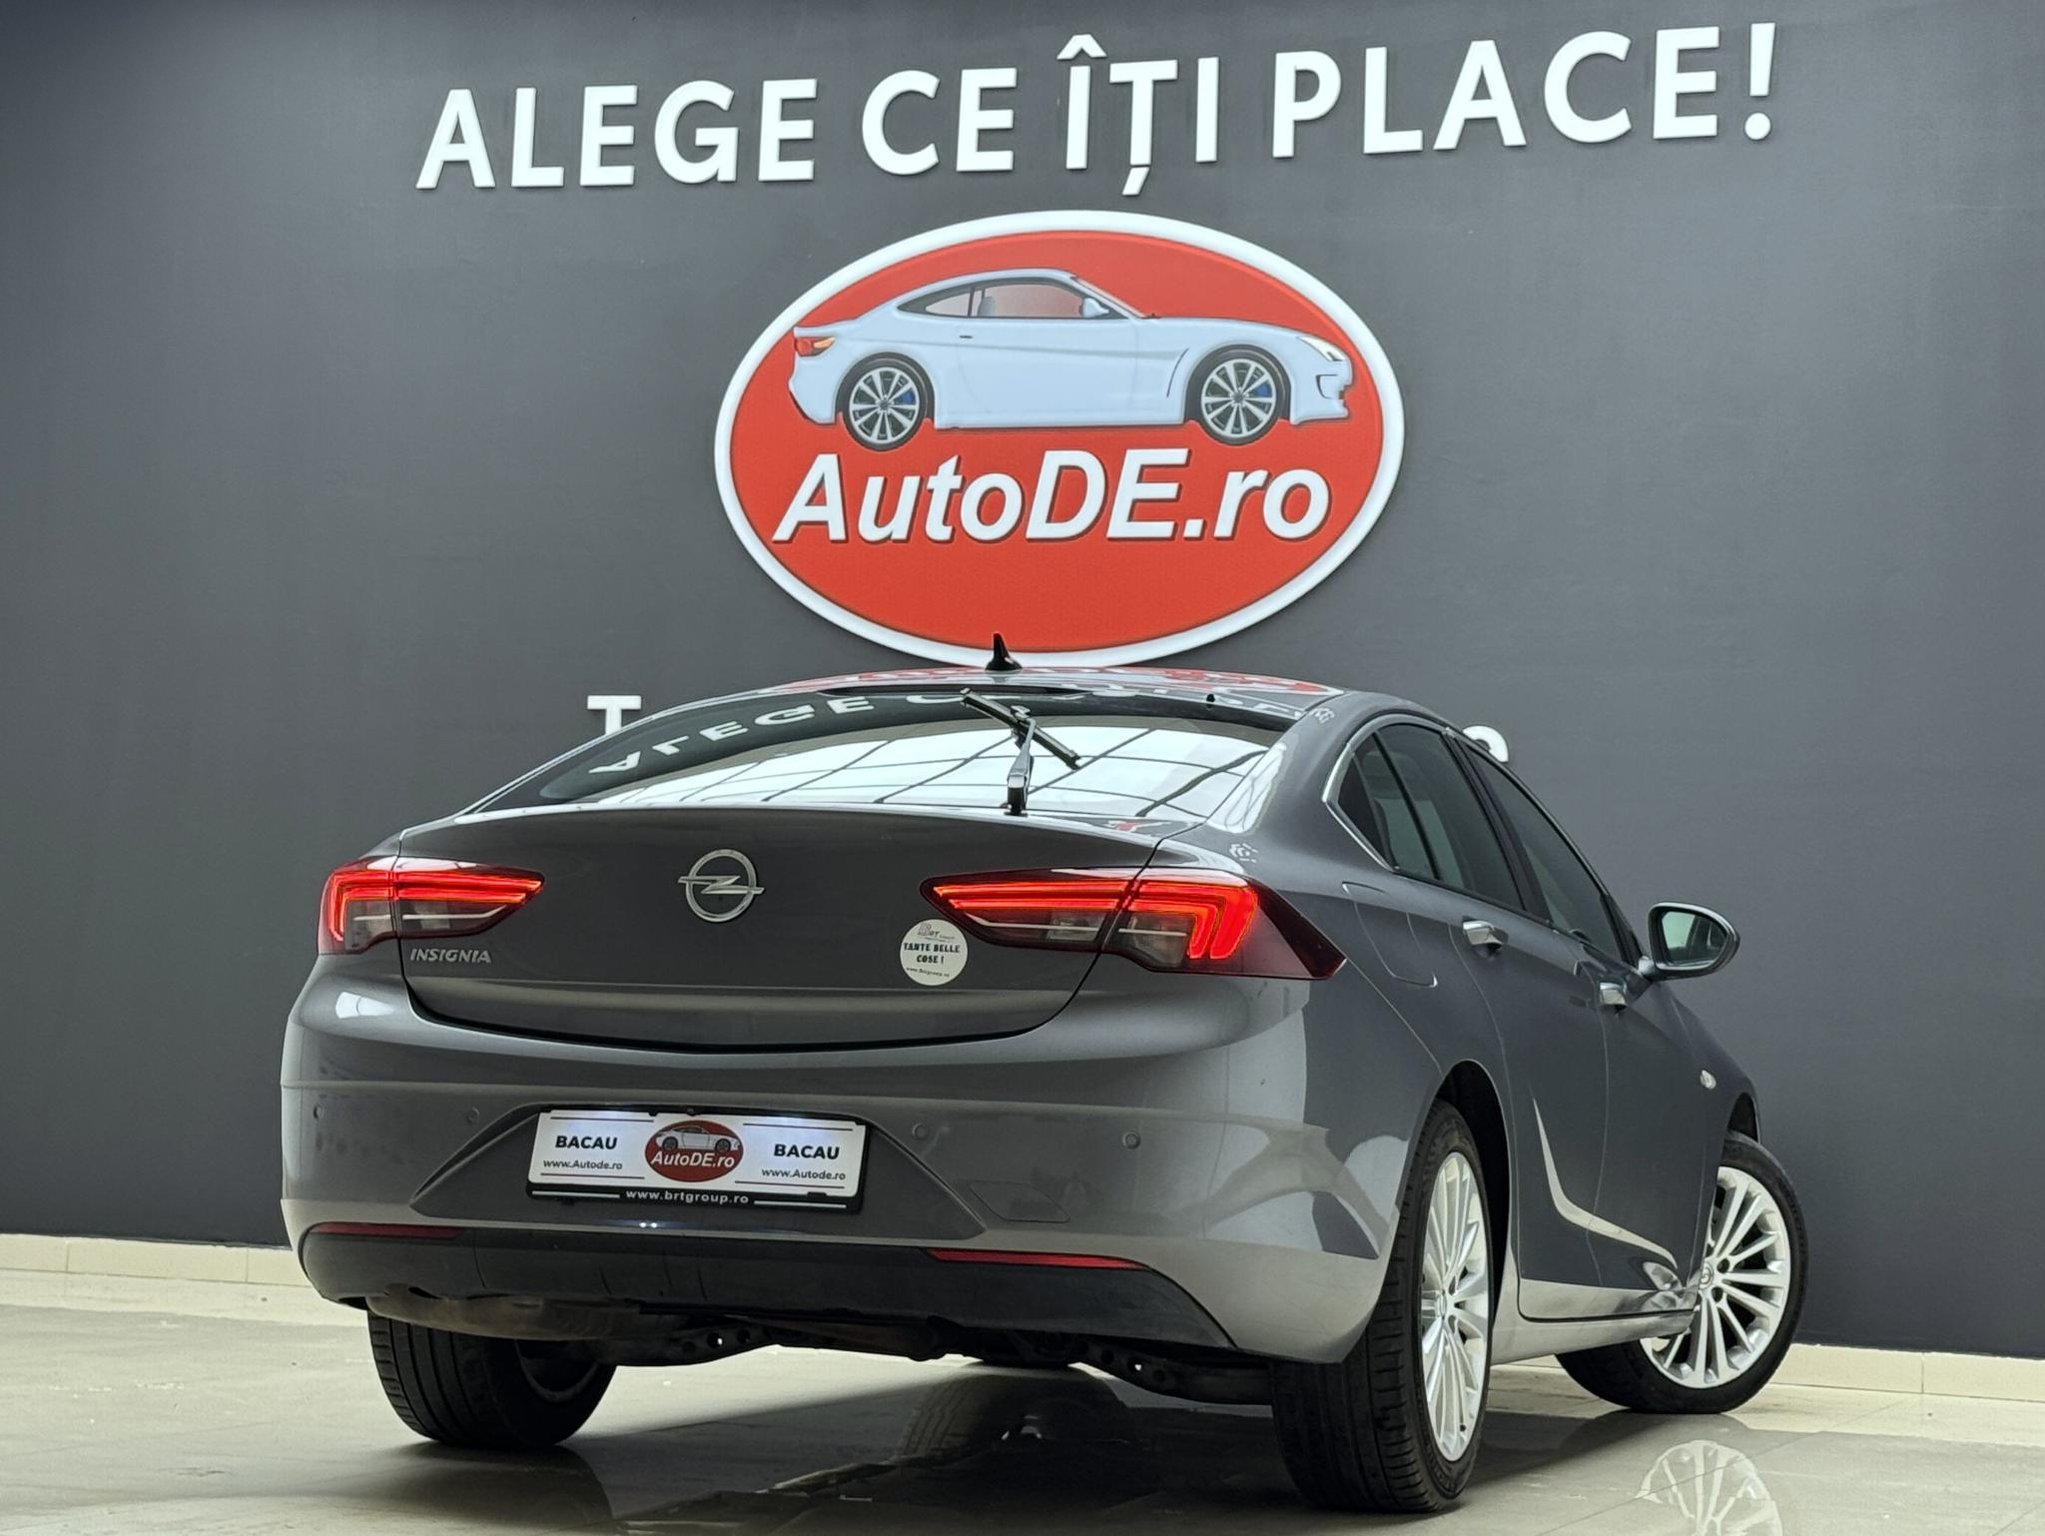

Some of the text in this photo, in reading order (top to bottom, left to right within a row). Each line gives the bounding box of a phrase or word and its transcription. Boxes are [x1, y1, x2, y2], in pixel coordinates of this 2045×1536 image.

[416, 78, 818, 189] ALEGE
[861, 67, 1018, 175] CE
[1272, 22, 1776, 158] PLACE!
[772, 447, 1331, 544] AutoDE.ro
[410, 948, 491, 963] INSIGNIA
[903, 943, 960, 953] TANTE BELLE
[916, 955, 938, 964] COSE
[555, 1135, 618, 1150] BACAU
[773, 1143, 840, 1160] BACAU
[650, 1151, 735, 1168] AutoDE.ro
[761, 1168, 846, 1181] www.Autode.ro
[625, 1190, 749, 1205] www.brtgroup.ro
